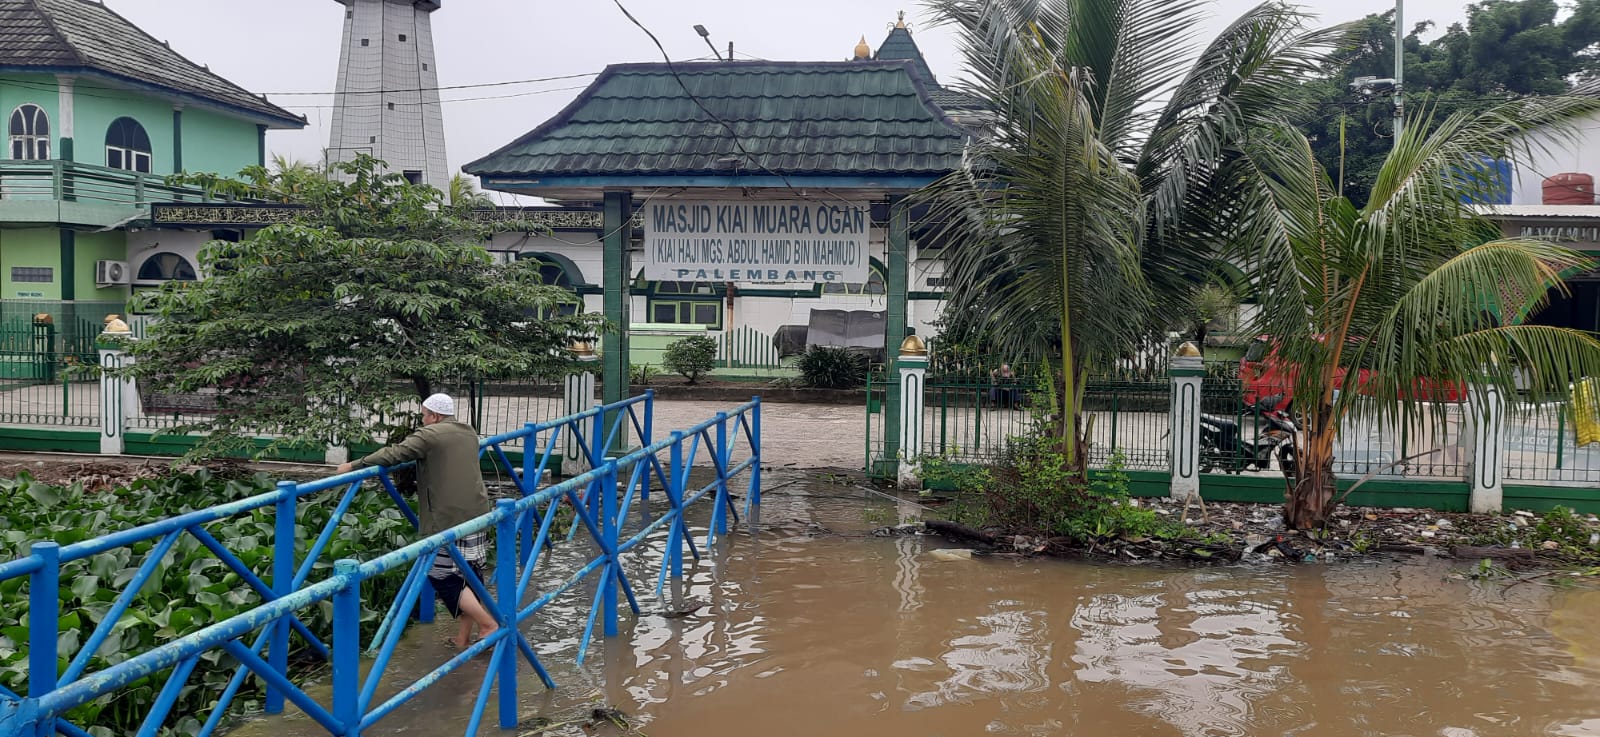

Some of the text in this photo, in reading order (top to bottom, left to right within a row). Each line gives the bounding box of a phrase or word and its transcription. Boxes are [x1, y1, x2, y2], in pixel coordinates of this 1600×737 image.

[653, 205, 864, 234] MASJID KIAI MUARA OGAN
[678, 239, 697, 264] HAJI
[701, 239, 725, 264] MGS.
[727, 239, 759, 265] ABDUL
[762, 239, 791, 265] HAMID
[794, 240, 810, 265] BIN
[813, 240, 855, 266] MAHMUD
[677, 269, 837, 281] PALEMBANG
